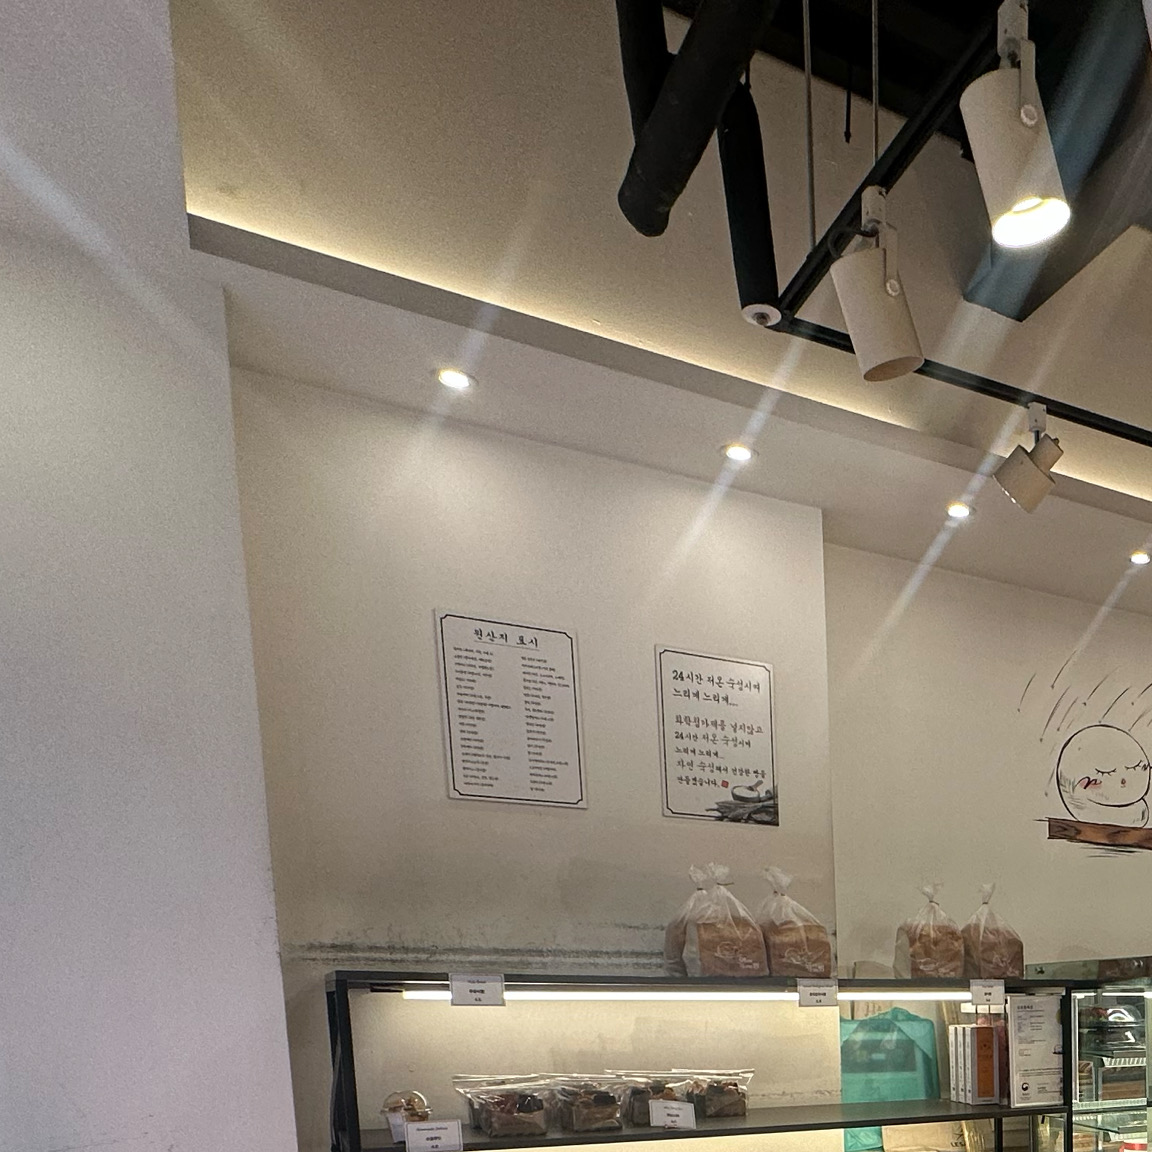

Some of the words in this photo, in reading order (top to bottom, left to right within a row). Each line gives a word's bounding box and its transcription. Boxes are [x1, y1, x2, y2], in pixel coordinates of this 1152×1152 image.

[474, 628, 508, 643] 원산지
[516, 635, 538, 648] 표시
[672, 670, 703, 685] 24시간
[707, 675, 724, 689] 저온
[672, 688, 700, 702] 느리게
[674, 731, 698, 742] 24시간
[701, 732, 719, 745] 저온
